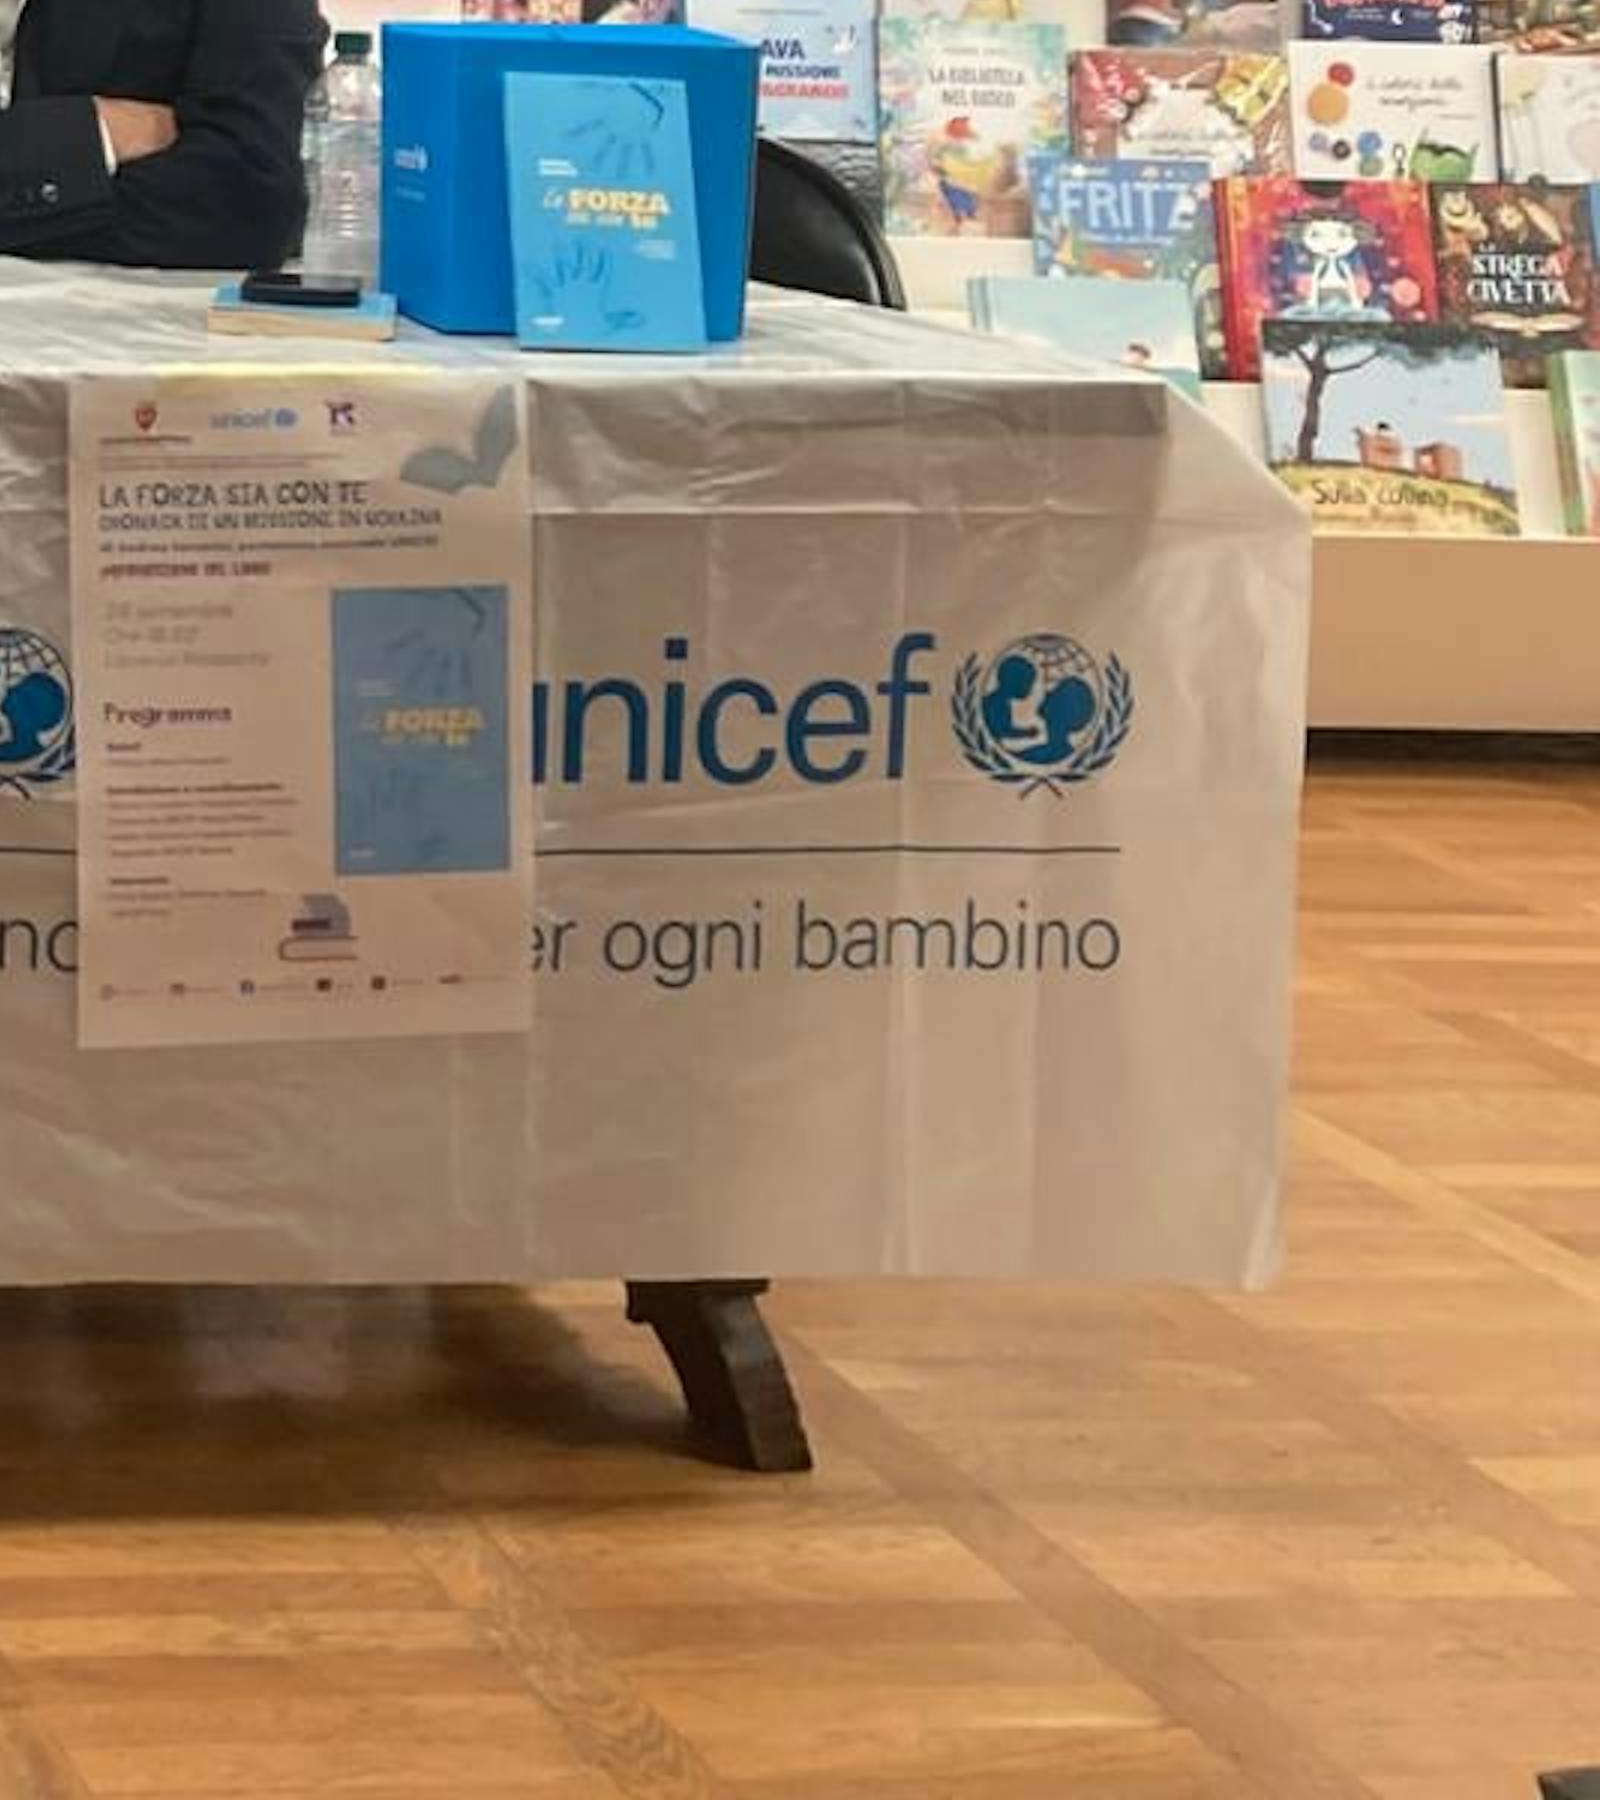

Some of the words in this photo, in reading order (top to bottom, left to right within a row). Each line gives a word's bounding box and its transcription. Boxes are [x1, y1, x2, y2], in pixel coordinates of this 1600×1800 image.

[568, 187, 672, 215] FORZA
[1472, 253, 1564, 279] STREGA
[1466, 279, 1572, 306] CIVETTA
[100, 483, 130, 508] LA
[137, 480, 218, 507] FORZA
[227, 483, 269, 506] SIA
[276, 480, 331, 506] CON
[337, 481, 370, 504] TE
[340, 508, 361, 528] IN
[103, 701, 233, 729] Programma
[603, 901, 762, 989] ogni
[797, 899, 1122, 971] bambino
